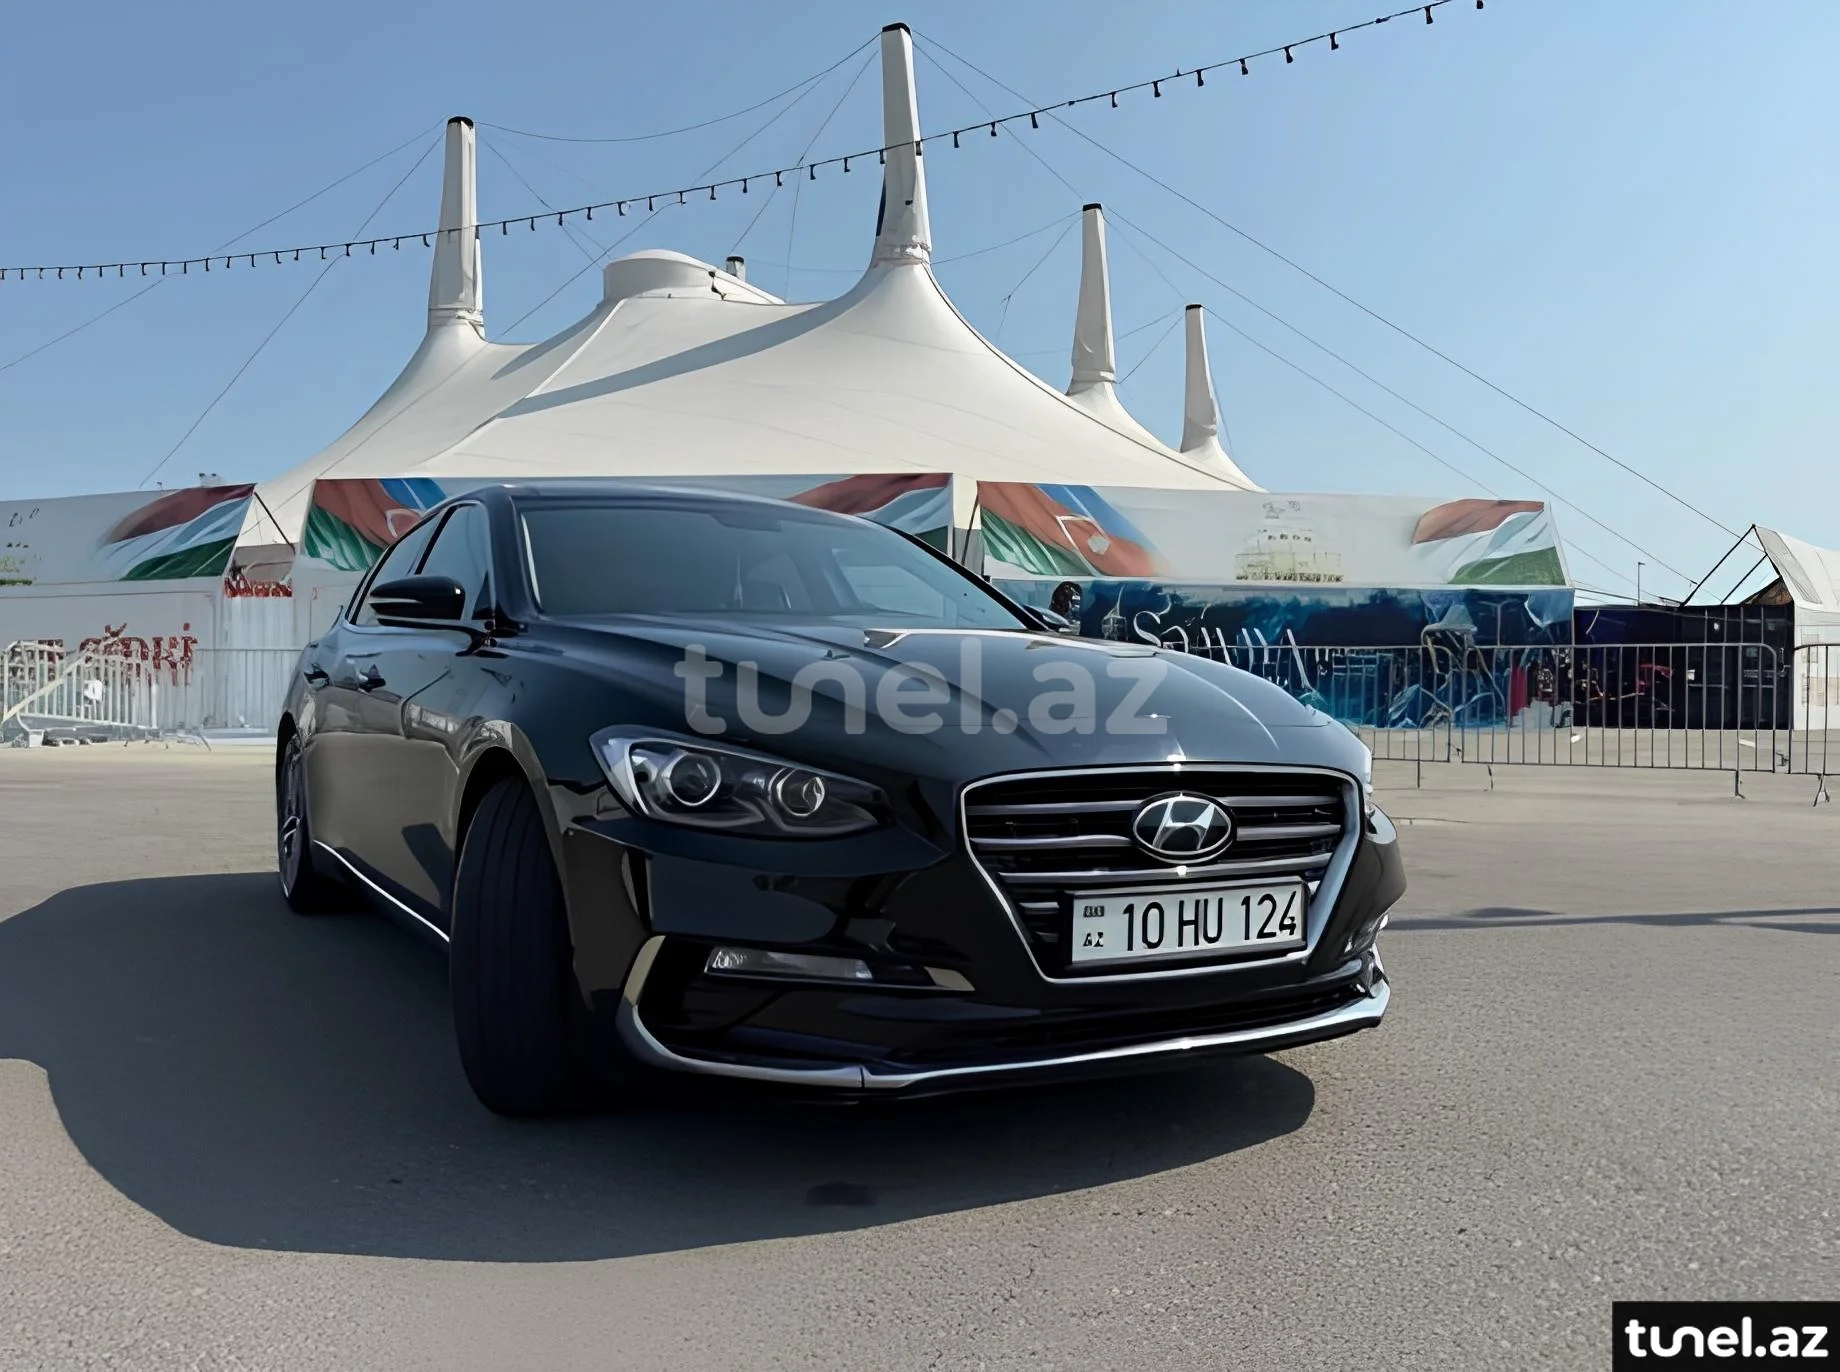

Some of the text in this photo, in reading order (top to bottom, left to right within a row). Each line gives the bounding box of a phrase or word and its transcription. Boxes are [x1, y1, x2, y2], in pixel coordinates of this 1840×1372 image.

[1123, 891, 1297, 951] 10 HU 124
